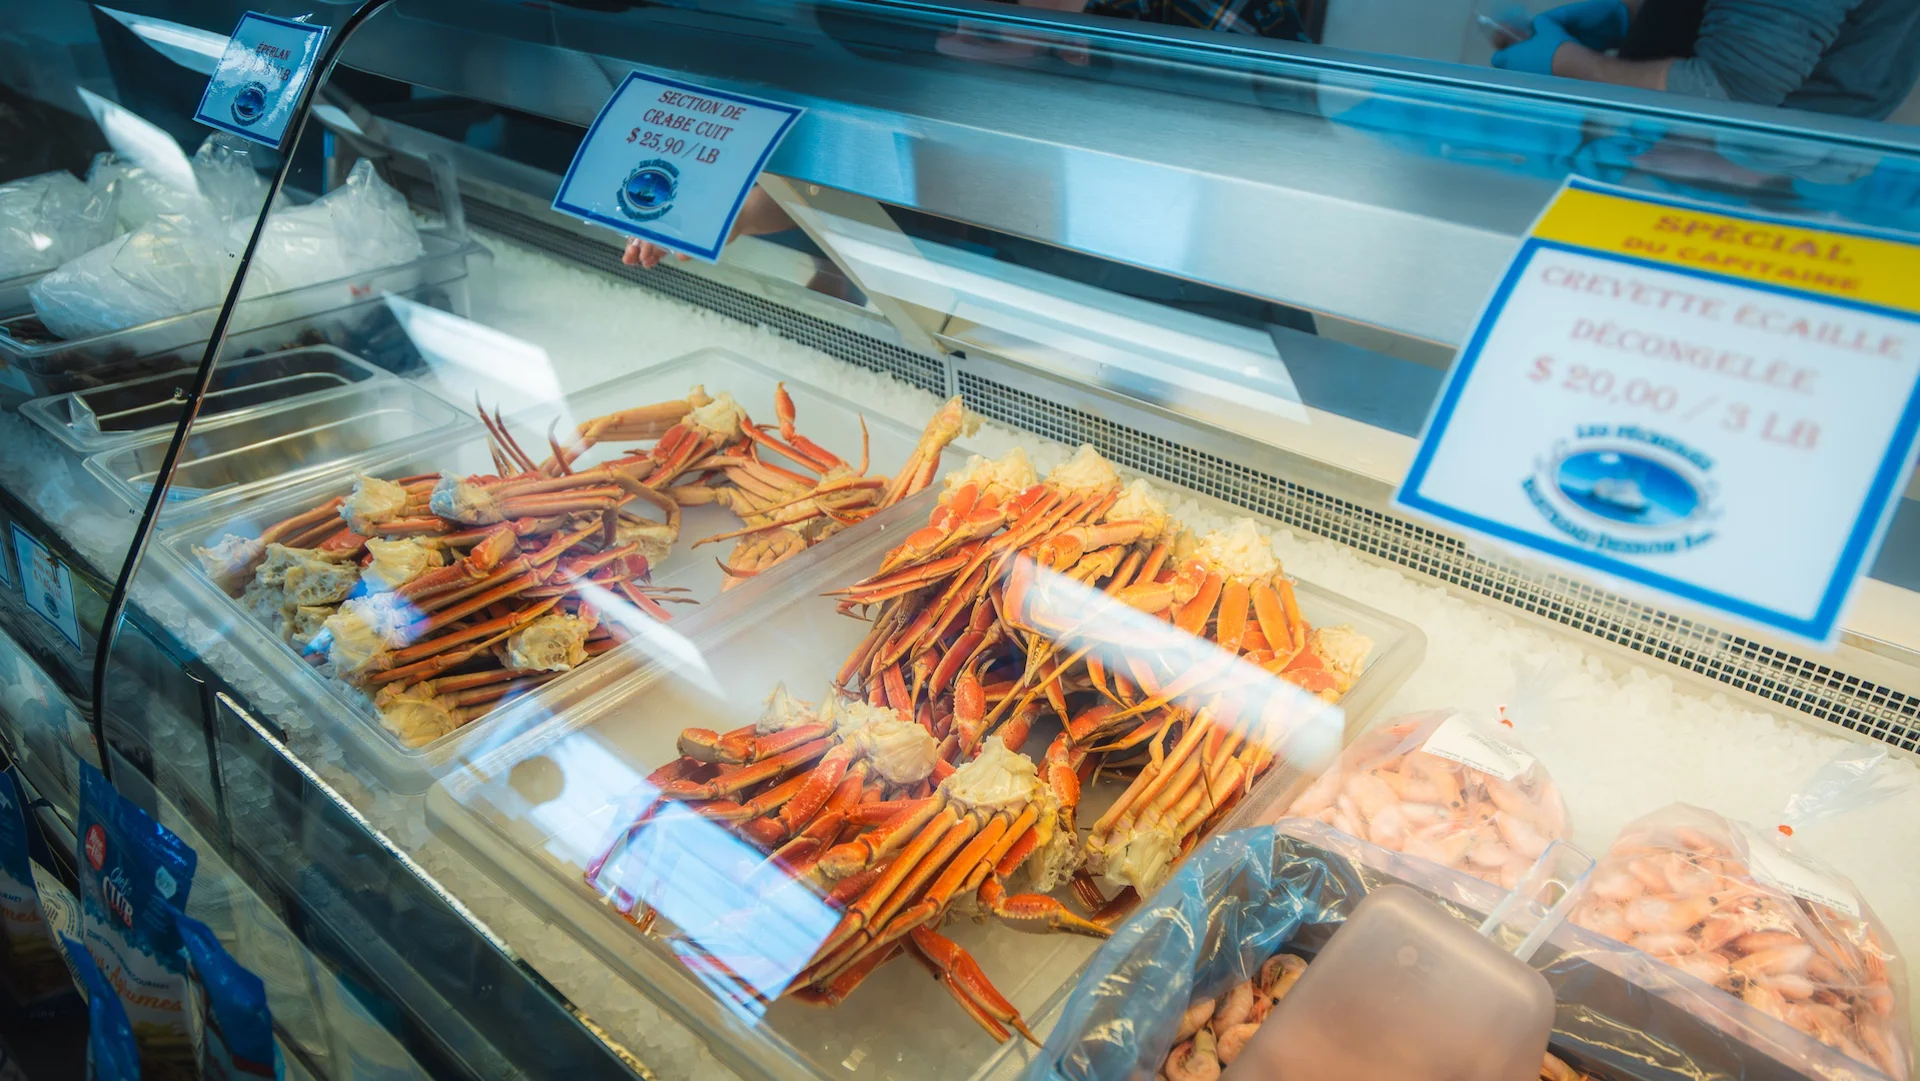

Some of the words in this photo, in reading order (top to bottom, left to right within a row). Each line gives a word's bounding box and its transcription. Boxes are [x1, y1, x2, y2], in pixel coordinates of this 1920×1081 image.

[256, 41, 291, 60] ÉPERLAN
[643, 108, 696, 132] CRABE
[695, 121, 735, 142] CUIT
[658, 90, 720, 115] SECTION
[723, 104, 747, 121] DE
[626, 127, 640, 144] $
[639, 132, 685, 155] 25,90
[681, 143, 699, 158] /
[696, 148, 720, 164] LB
[1654, 214, 1855, 266] SPÉCIAL
[1622, 236, 1668, 255] DU
[1676, 248, 1863, 292] CAPITAINE
[1541, 265, 1726, 320] CREVETTE
[1527, 355, 1555, 384] $
[1562, 364, 1680, 413] 20,00
[1679, 394, 1720, 421] /
[1721, 401, 1751, 434] 3
[1760, 411, 1821, 451] LB
